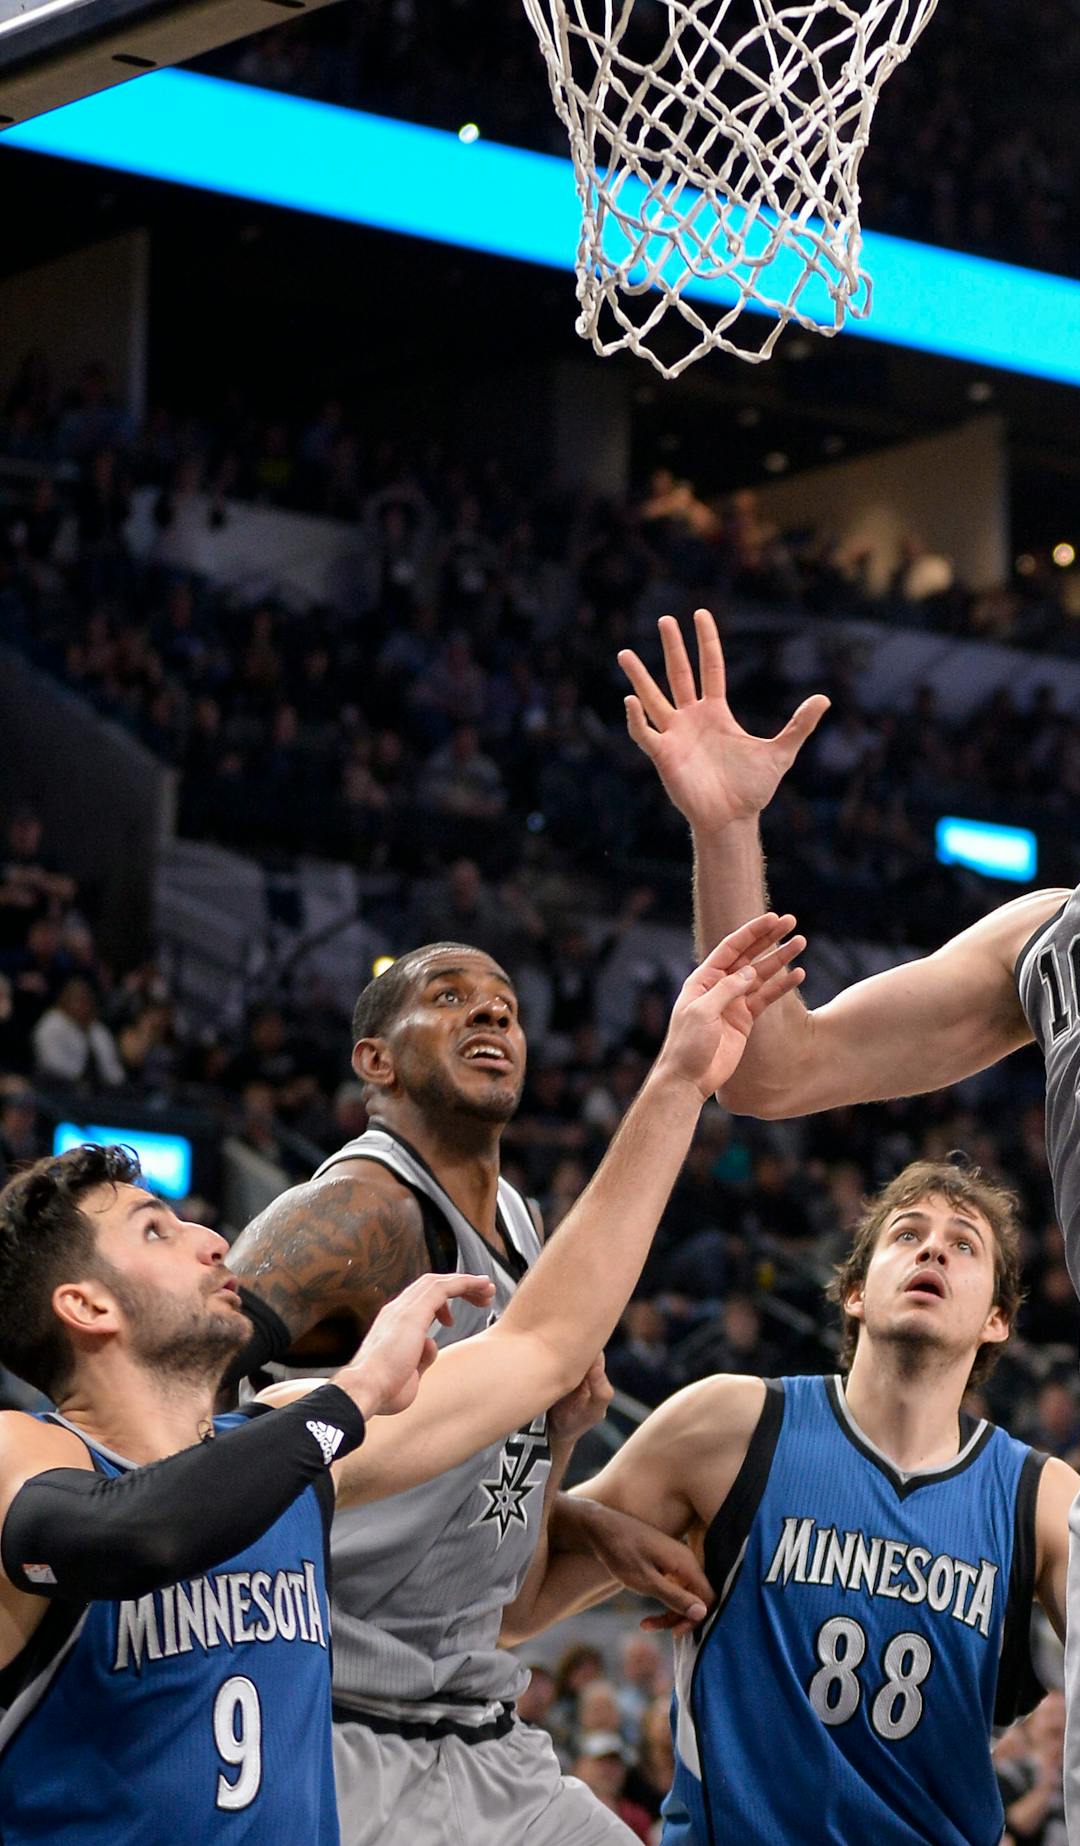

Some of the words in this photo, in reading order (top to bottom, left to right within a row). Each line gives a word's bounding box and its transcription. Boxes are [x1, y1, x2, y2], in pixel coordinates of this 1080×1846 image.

[112, 1559, 327, 1677] MINNESOTA
[764, 1517, 999, 1639] MINNESOTA
[808, 1615, 932, 1741] 88
[212, 1675, 262, 1811] 9
